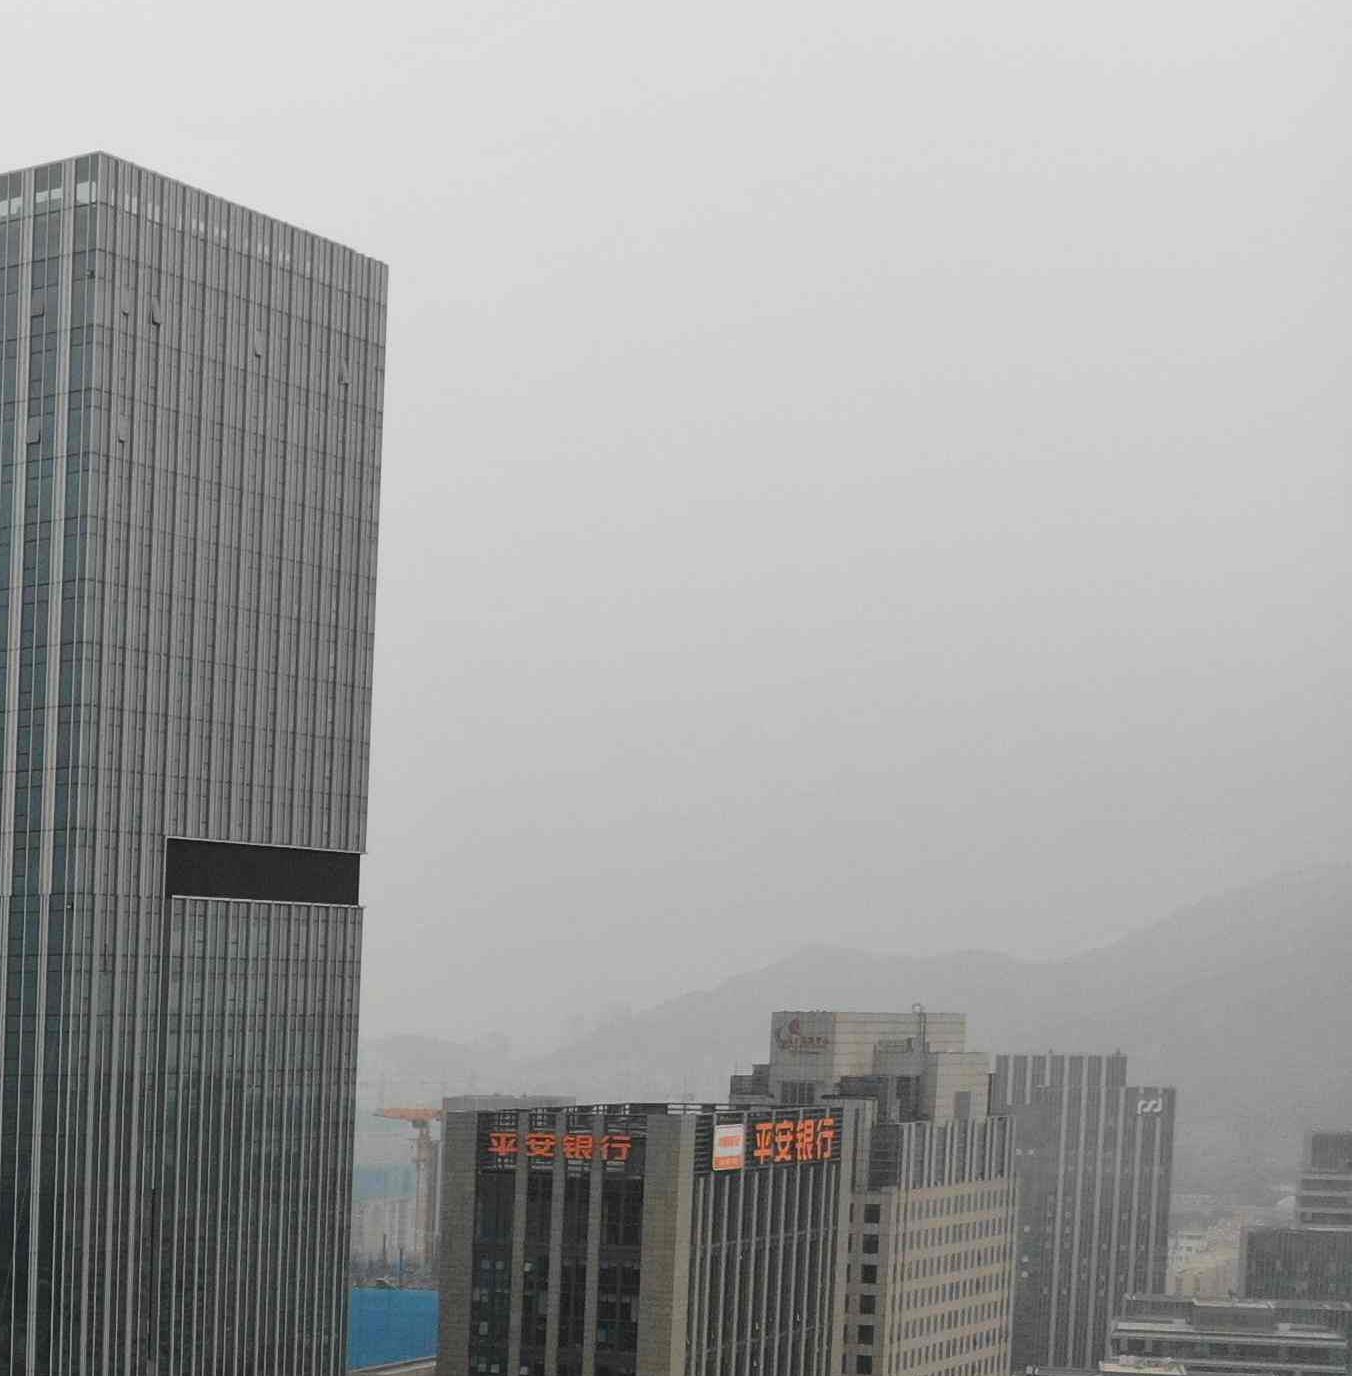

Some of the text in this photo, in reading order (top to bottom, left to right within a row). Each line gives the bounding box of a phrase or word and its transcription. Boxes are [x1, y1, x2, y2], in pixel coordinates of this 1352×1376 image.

[488, 1132, 632, 1161] 平安银行
[753, 1117, 835, 1165] 平安银行
